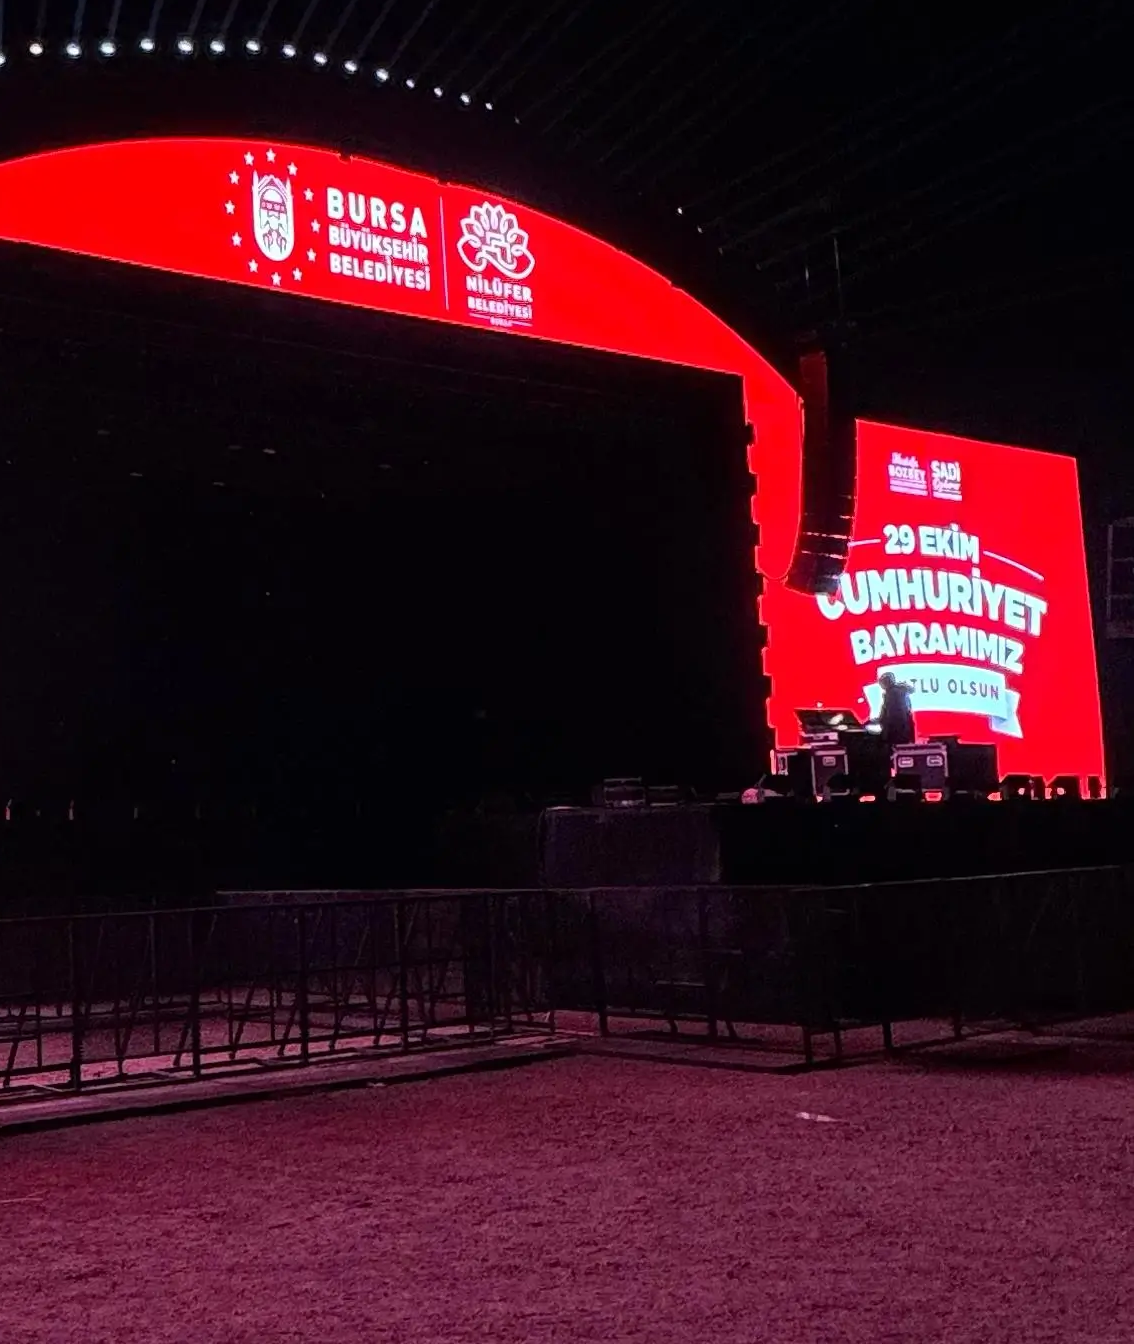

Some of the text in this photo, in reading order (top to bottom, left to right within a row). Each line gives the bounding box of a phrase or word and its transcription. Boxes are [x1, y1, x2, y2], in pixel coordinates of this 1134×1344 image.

[326, 187, 428, 238] BURSA
[328, 221, 429, 265] BÜYÜKŞEHİR
[329, 252, 431, 292] BELEDİYESİ
[466, 274, 533, 303] NİLÜFER
[467, 296, 533, 320] BELEDİYESİ
[882, 523, 980, 564] 29 EKİM
[850, 622, 1024, 675] BAYRAMIMIZ
[947, 678, 999, 700] OLSUN
